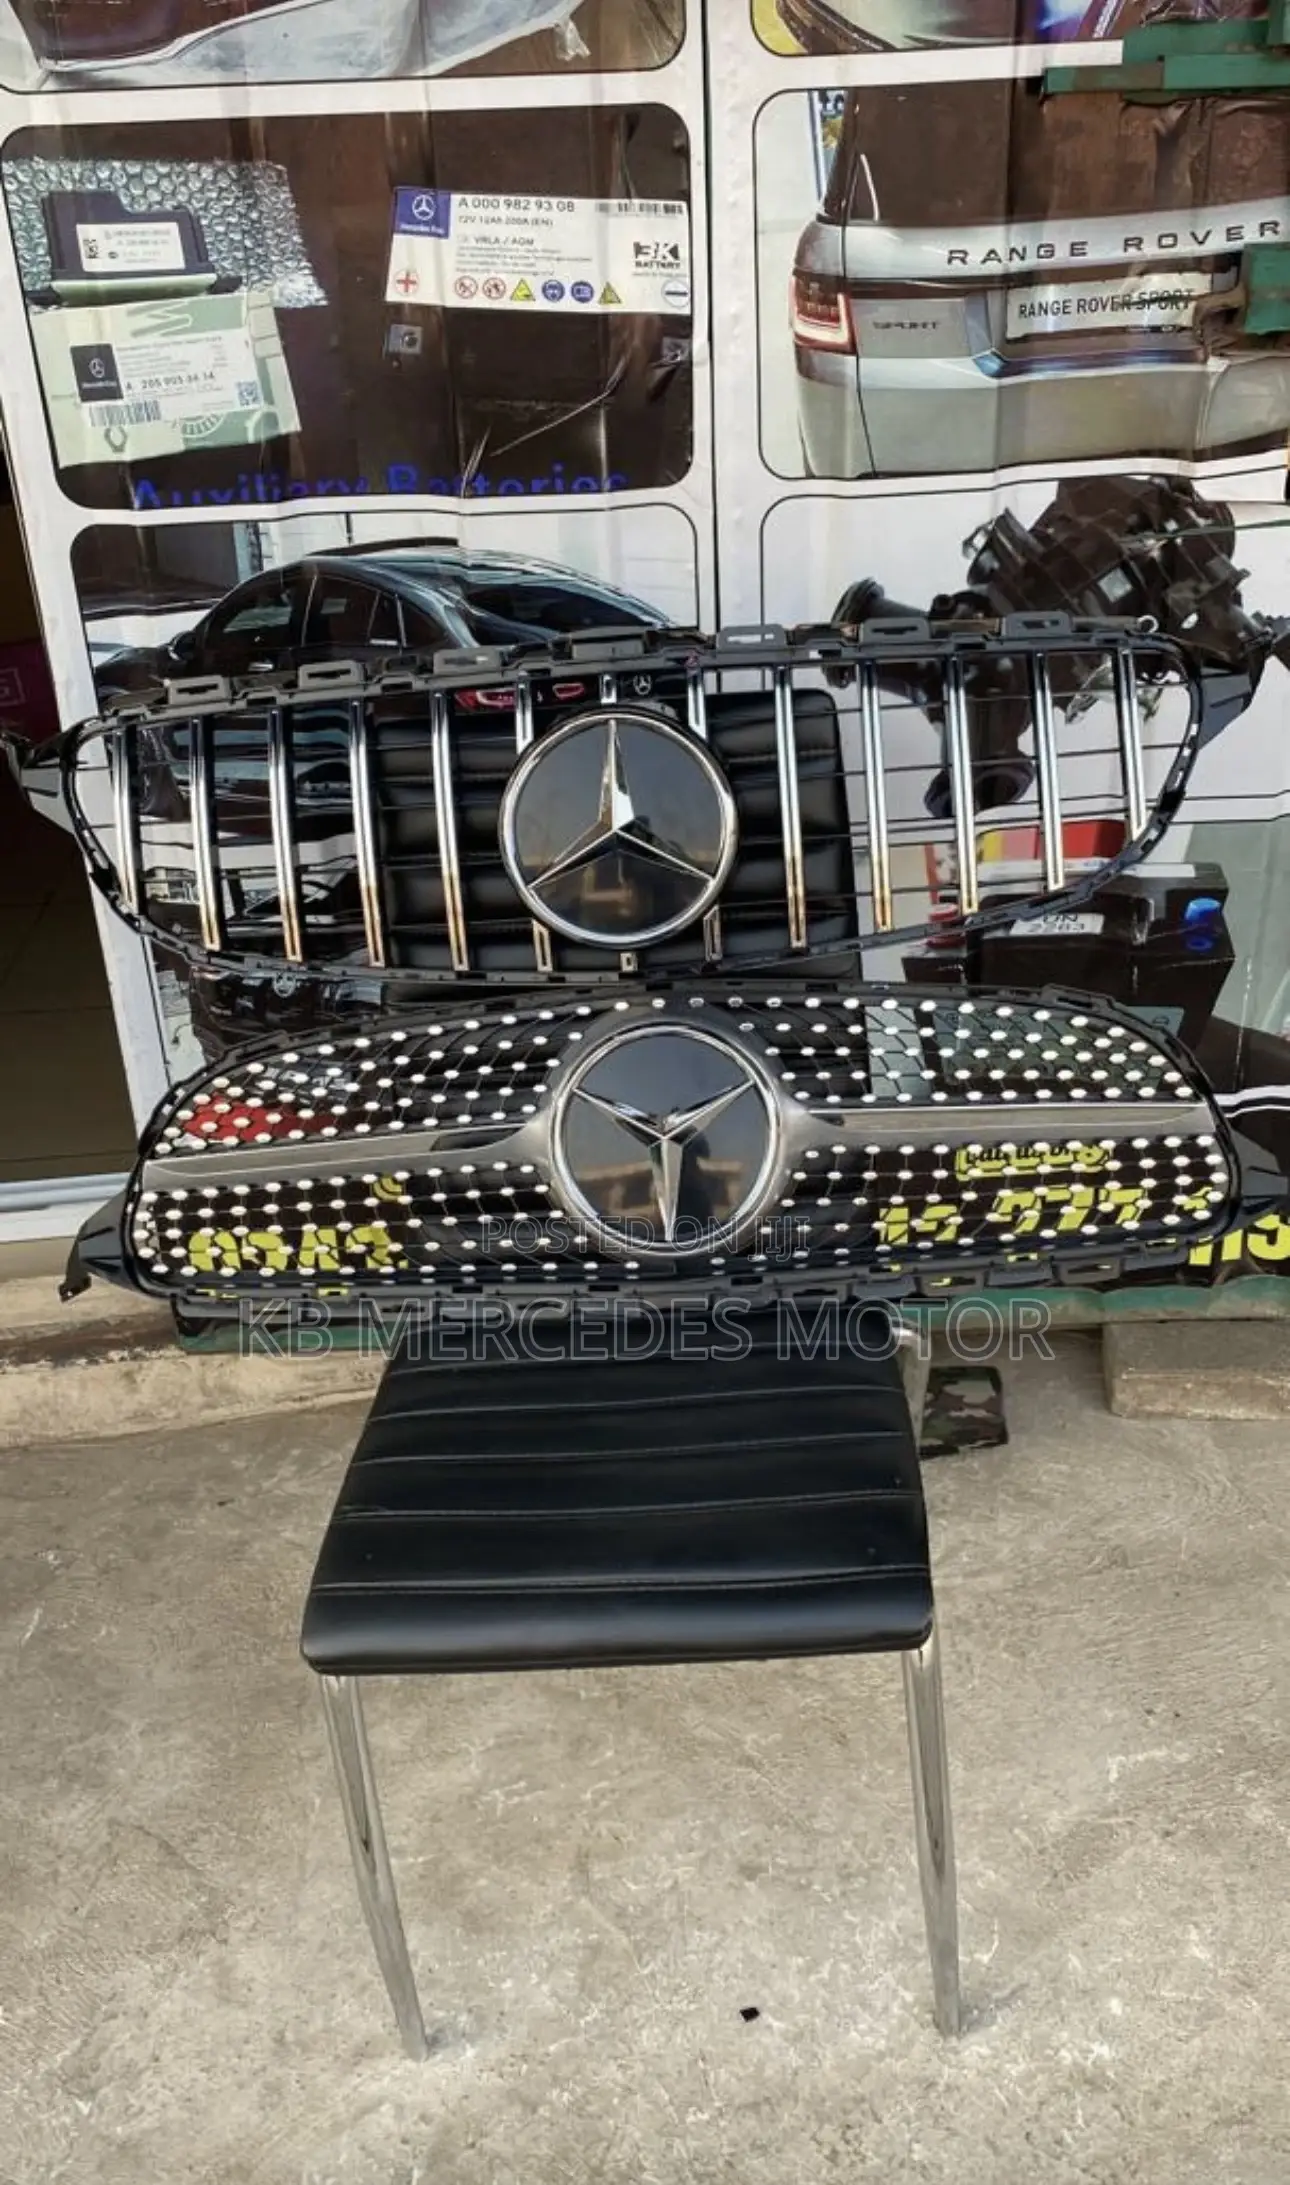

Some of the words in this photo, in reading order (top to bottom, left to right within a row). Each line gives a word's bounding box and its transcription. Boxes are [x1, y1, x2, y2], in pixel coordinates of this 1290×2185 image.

[458, 198, 468, 208] A
[503, 200, 530, 210] 982
[535, 201, 553, 211] 93
[947, 241, 1089, 266] RANGE
[1123, 220, 1281, 252] ROVER
[1018, 298, 1072, 319] RANGE
[1076, 293, 1133, 314] ROVER
[1134, 289, 1194, 312] SPORT
